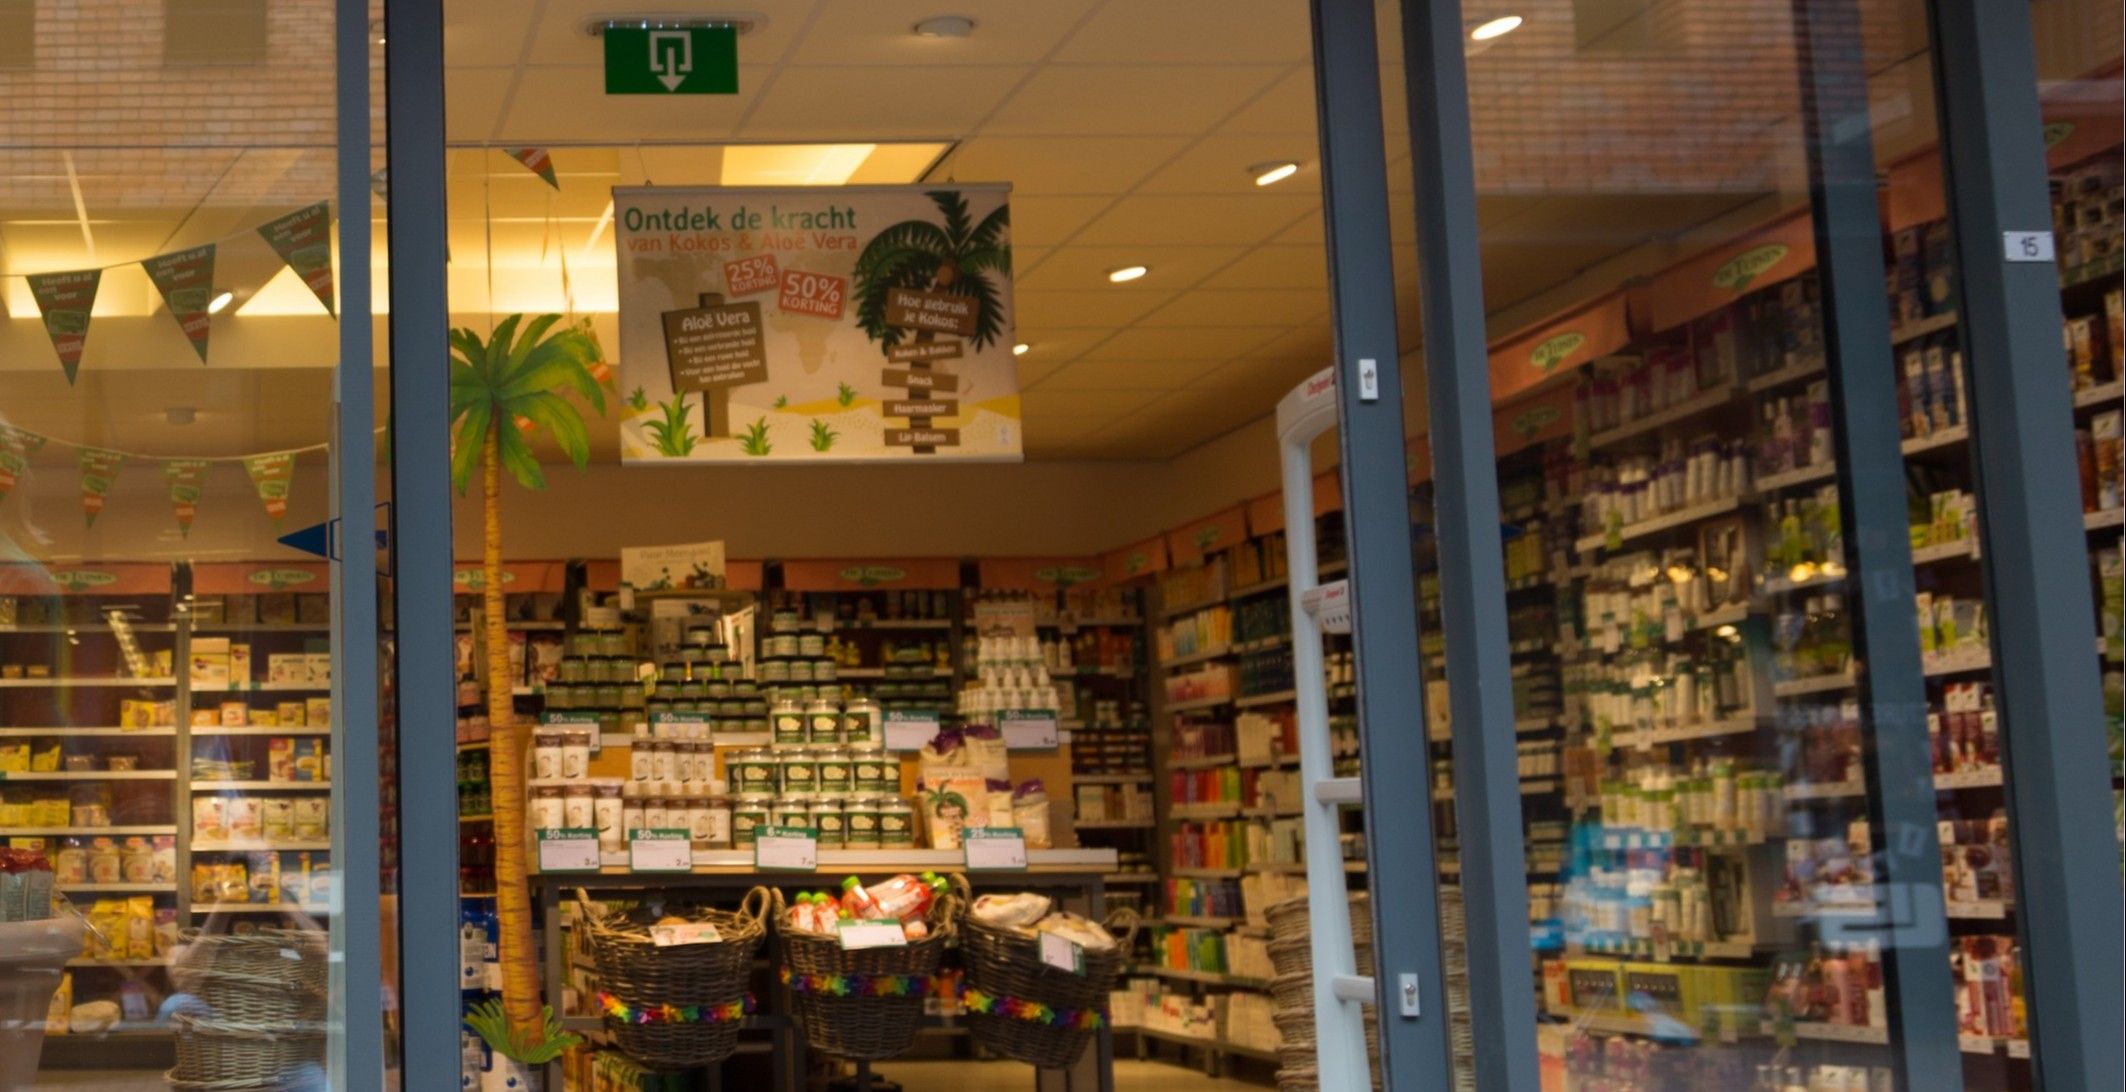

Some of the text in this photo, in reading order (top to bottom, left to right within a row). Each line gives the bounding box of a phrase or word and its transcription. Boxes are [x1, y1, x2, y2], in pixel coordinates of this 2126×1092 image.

[624, 205, 857, 232] Ontdek de kracht
[627, 232, 858, 252] van Kokos & Aloë Vera
[2021, 237, 2039, 256] 15
[727, 256, 775, 282] 25%
[731, 277, 777, 293] KORTING
[785, 273, 840, 303] 50%
[782, 297, 838, 315] KORTING
[897, 293, 921, 308] Hoe
[682, 311, 751, 331] Aloë Vera
[904, 310, 959, 329] je Kokos:
